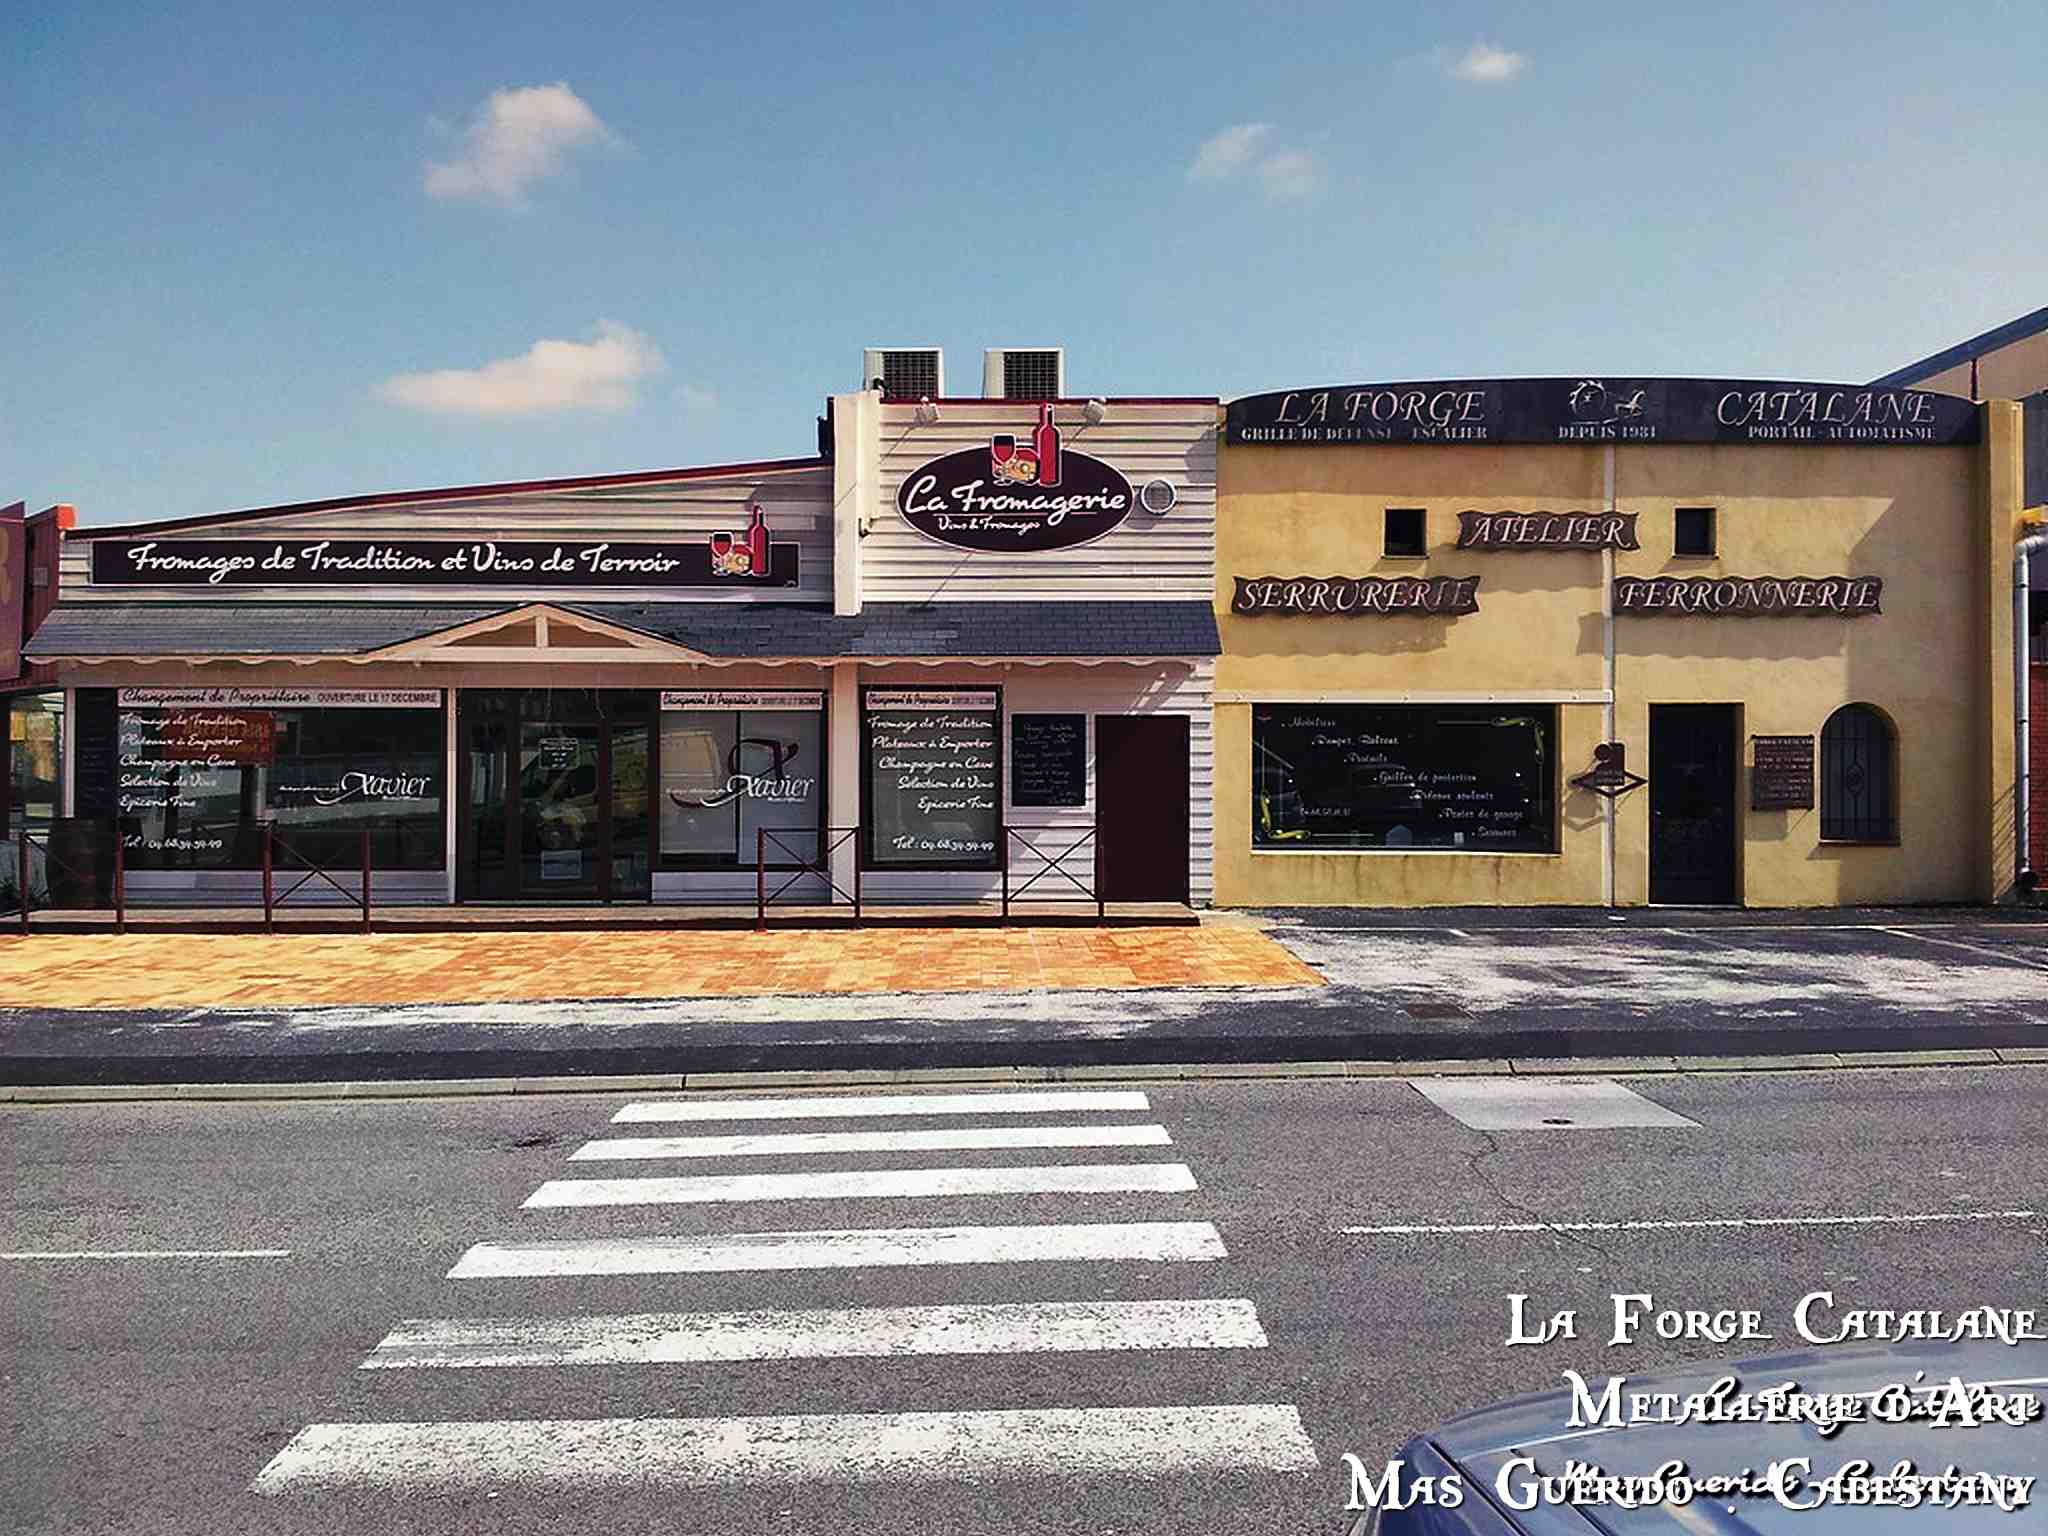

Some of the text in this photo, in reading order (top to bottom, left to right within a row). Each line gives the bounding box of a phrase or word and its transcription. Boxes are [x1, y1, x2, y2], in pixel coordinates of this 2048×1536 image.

[1275, 391, 1486, 428] LA FORGE
[1717, 390, 1937, 427] CATALANE
[1241, 427, 1297, 441] GRILLE
[1302, 427, 1321, 440] DE
[1559, 426, 1616, 438] DEPUIS
[1748, 425, 1815, 438] PORTAIL
[905, 475, 1127, 526] La Fromagerie
[938, 515, 968, 530] Vins
[979, 516, 1040, 536] Fromages
[1468, 517, 1631, 548] ATELIER
[127, 541, 681, 584] Fromages de Tradition et Vins de Terroir
[1237, 581, 1472, 613] SERRURERIE
[1619, 582, 1880, 614] FERRONNERIE
[122, 687, 207, 707] Changement
[208, 688, 225, 702] de
[318, 692, 366, 703] OUVERTURE
[368, 692, 380, 703] LE
[867, 715, 993, 733] Fromage de Tradition
[938, 735, 993, 754] Emporter
[119, 753, 188, 772] Champagne
[879, 756, 946, 774] Champagne
[316, 771, 431, 805] Xavier
[703, 775, 815, 806] Xavier
[950, 776, 966, 790] de
